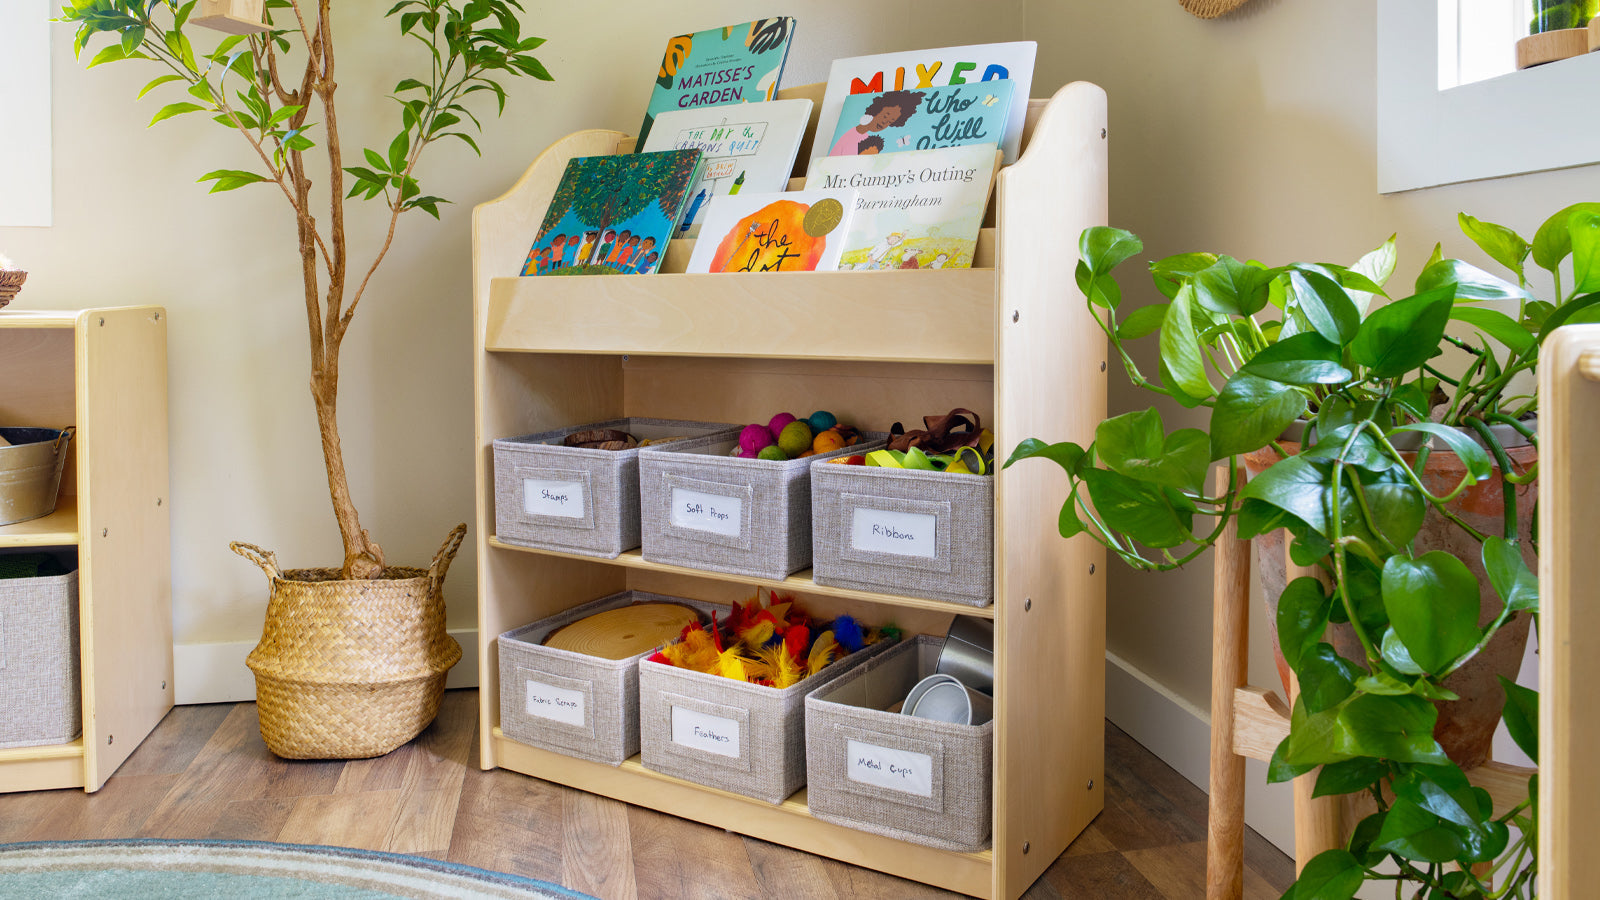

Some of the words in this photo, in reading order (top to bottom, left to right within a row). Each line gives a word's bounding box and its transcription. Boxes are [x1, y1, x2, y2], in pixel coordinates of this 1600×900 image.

[678, 65, 755, 90] MATISSE'S
[678, 86, 743, 108] GARDEN
[925, 88, 978, 114] Who
[710, 127, 735, 141] DAY
[931, 113, 987, 141] Will
[729, 140, 759, 155] QUIT
[823, 174, 847, 189] Mr.
[850, 169, 916, 188] Gumpy's
[919, 166, 977, 183] Outing
[754, 218, 792, 249] the
[541, 488, 569, 505] Stamps
[686, 502, 703, 514] Soft
[710, 507, 729, 520] Props
[872, 524, 915, 541] Ribbons
[532, 695, 552, 705] Fabric
[694, 726, 730, 742] Feathers
[857, 757, 882, 770] Metal
[889, 764, 913, 779] Cups
